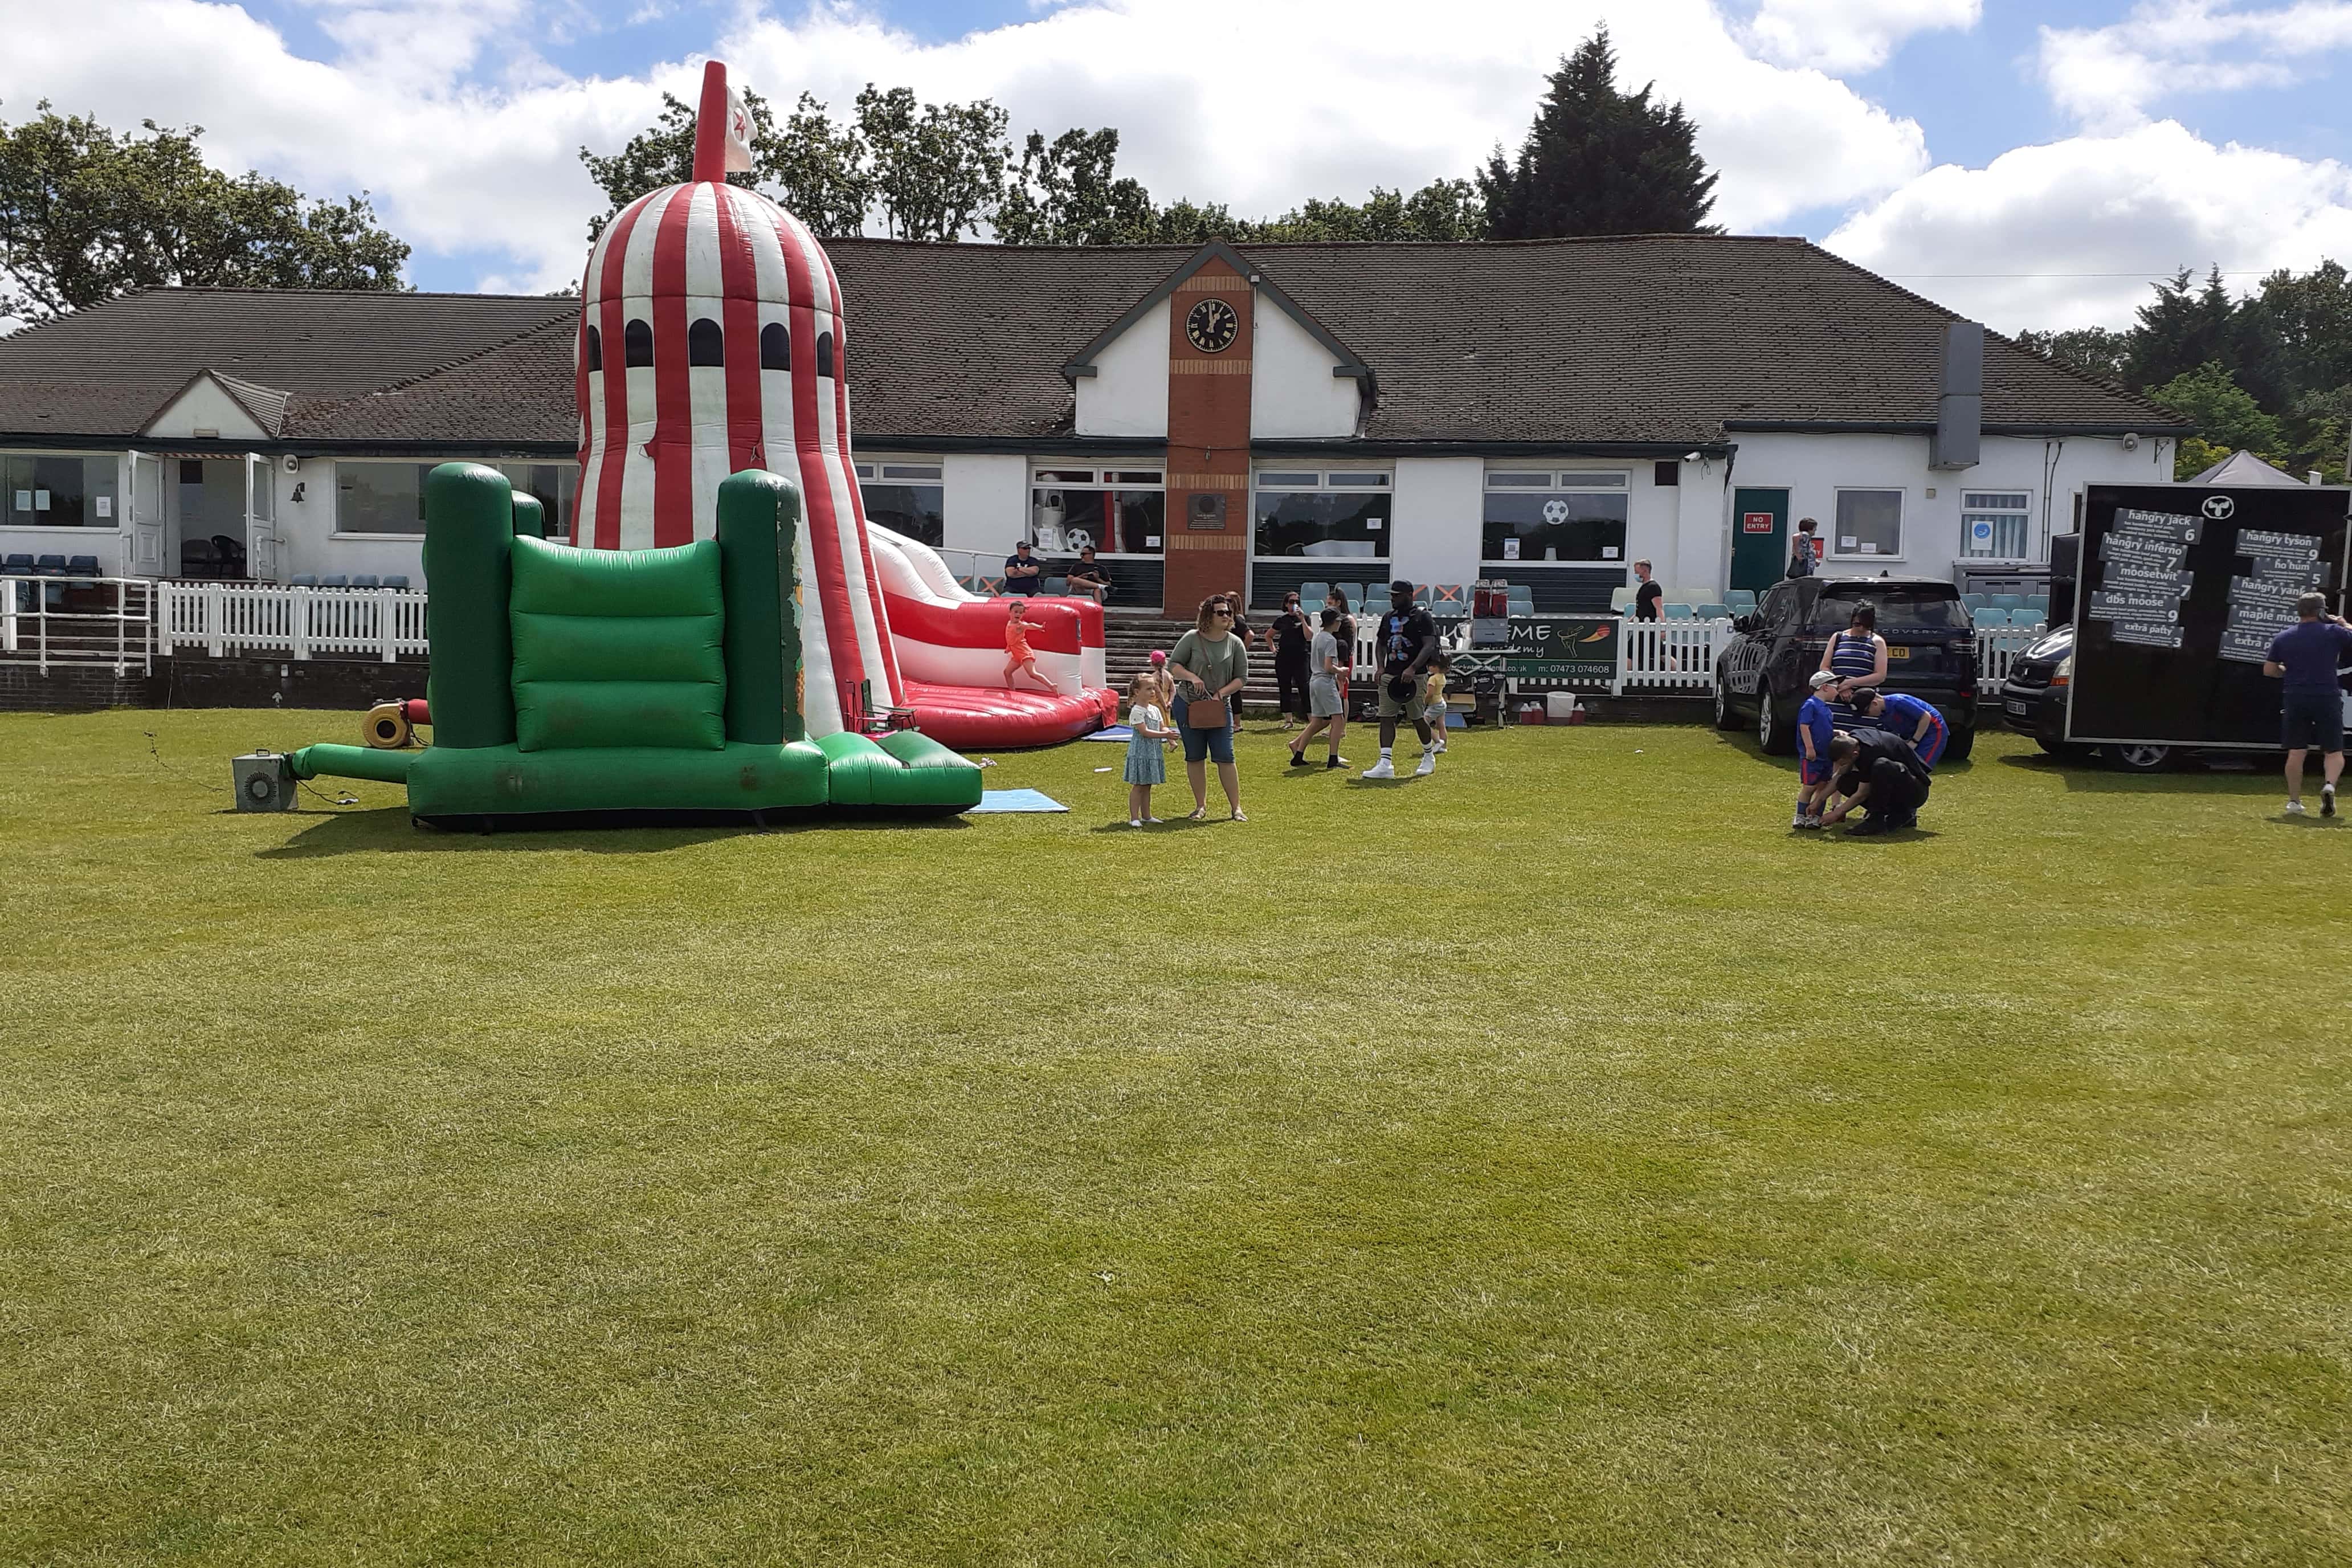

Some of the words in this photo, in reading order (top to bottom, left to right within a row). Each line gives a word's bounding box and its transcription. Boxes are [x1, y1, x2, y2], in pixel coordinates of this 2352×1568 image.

[2128, 509, 2166, 524] hangry
[2167, 514, 2191, 525] jack
[2184, 529, 2195, 541] 6
[2246, 532, 2282, 545] hangry
[2284, 536, 2312, 546] tyson
[2105, 536, 2142, 550] hangry
[2145, 542, 2182, 555] inferno
[2309, 549, 2318, 561] 9
[2166, 557, 2177, 569] 7
[2275, 560, 2286, 569] ho
[2289, 561, 2310, 570] hum
[2120, 568, 2178, 581] moosetwit
[2312, 573, 2321, 585] 5
[2180, 585, 2191, 597] 7
[2241, 579, 2279, 594] hangry
[2106, 595, 2125, 604] dbs
[2129, 598, 2164, 607] moose
[2168, 610, 2178, 622] 9
[2239, 610, 2273, 621] maple
[2276, 614, 2301, 623] moo
[2125, 623, 2147, 632] extra
[2149, 625, 2173, 636] patty
[2173, 637, 2182, 647] 3
[2235, 638, 2261, 648] extra
